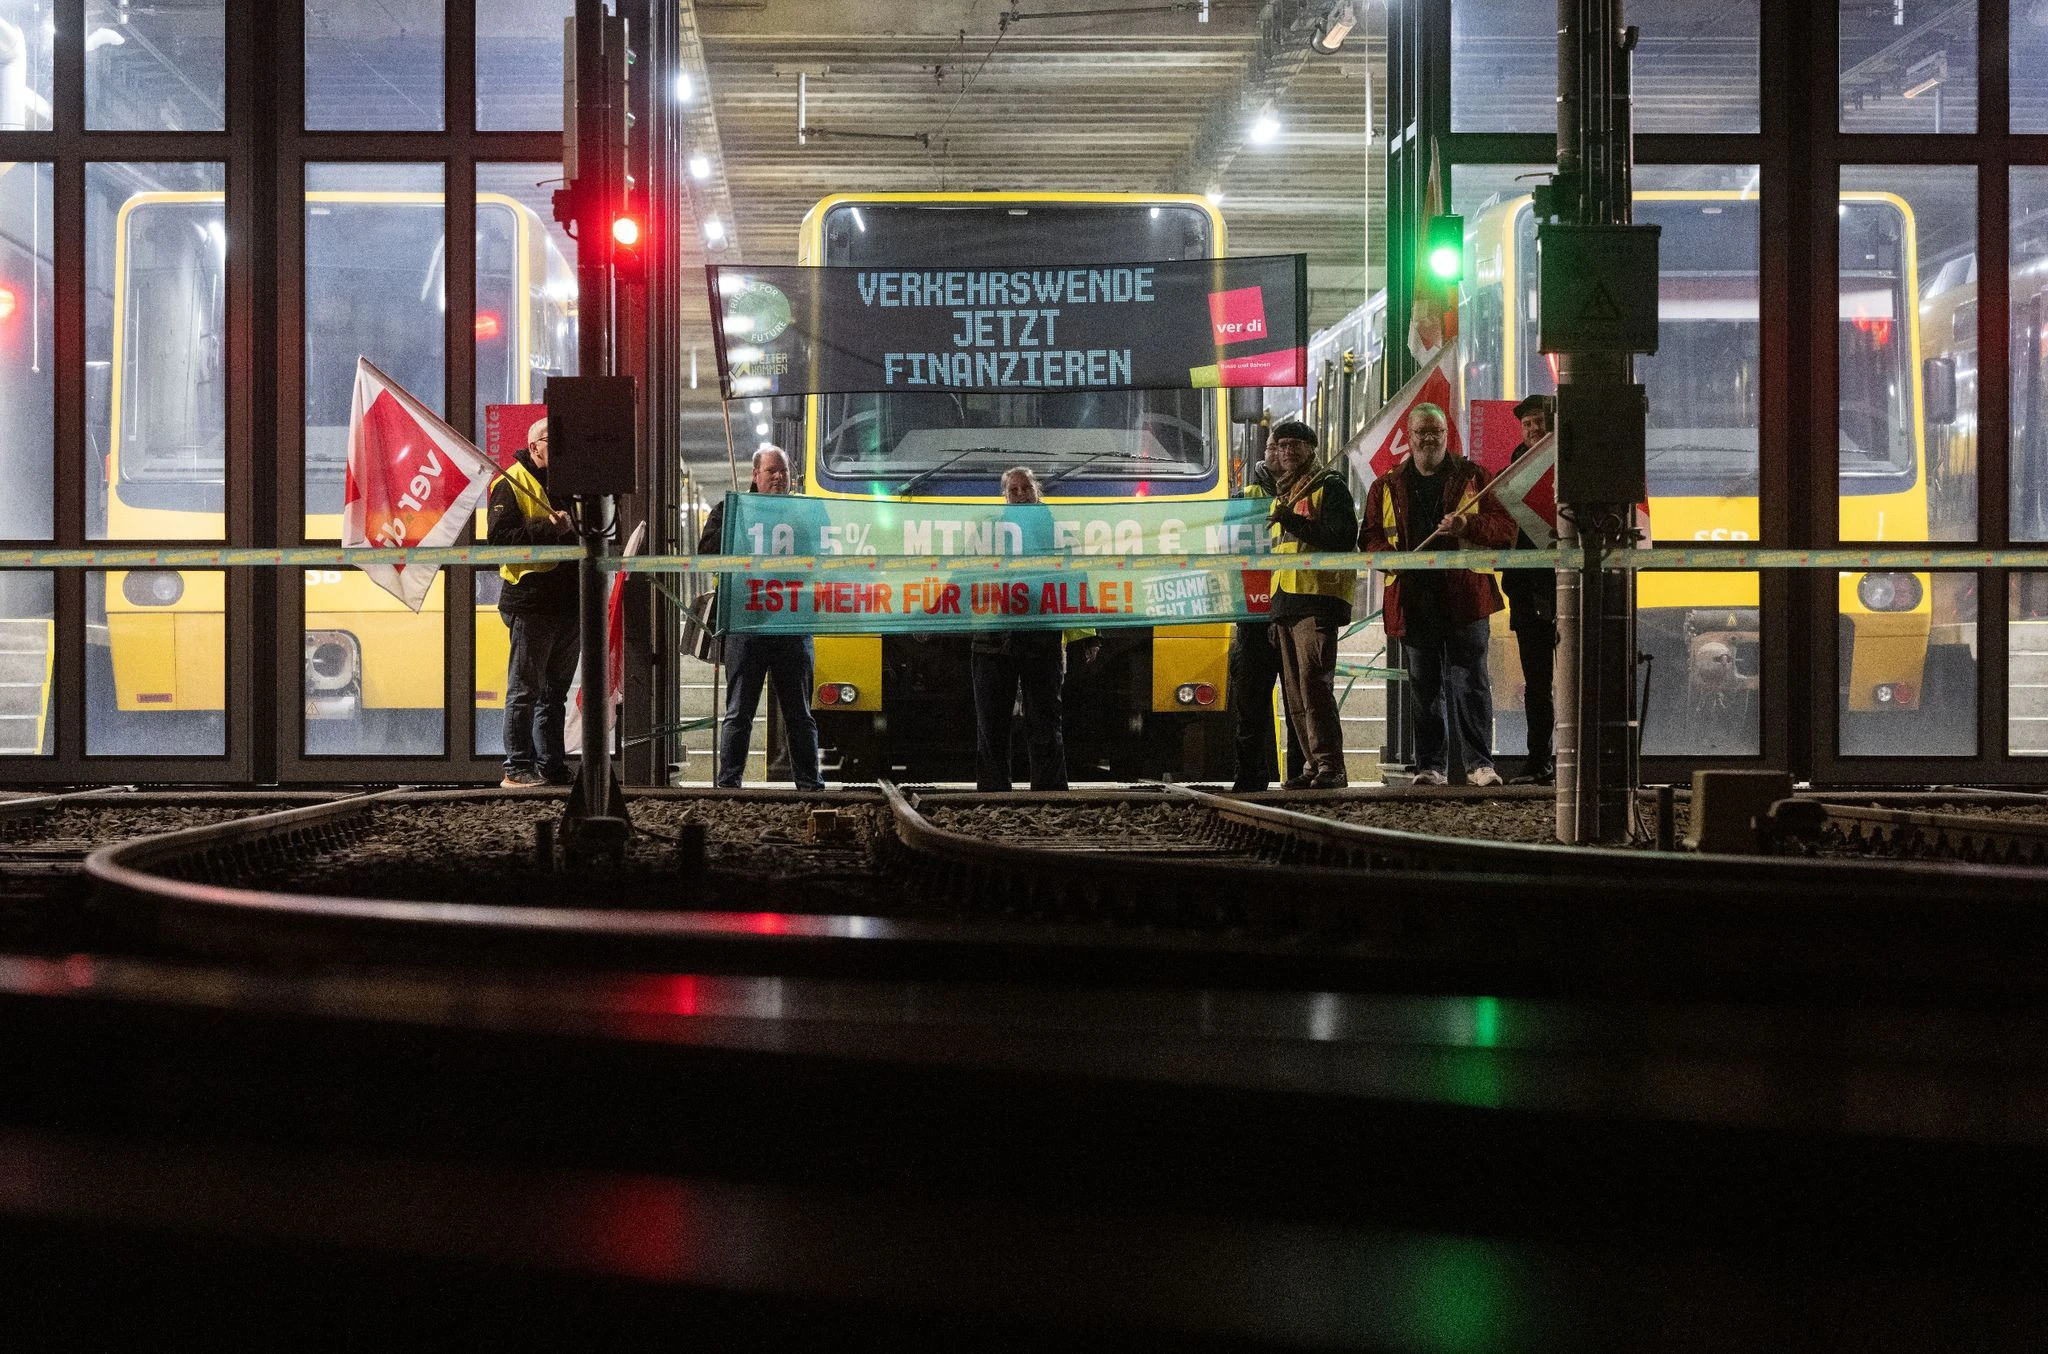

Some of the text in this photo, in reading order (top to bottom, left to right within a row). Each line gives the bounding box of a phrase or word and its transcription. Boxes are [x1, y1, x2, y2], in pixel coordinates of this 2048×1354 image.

[759, 284, 779, 297] FOR
[858, 267, 1155, 307] VERKEHRSWENDE
[751, 320, 787, 342] FUTURE
[953, 309, 1061, 347] JETZT
[884, 349, 1133, 387] FINANZIEREN
[1158, 518, 1188, 556] €
[744, 577, 1133, 615] IST MEHR FÜR UNS ALLE!
[1143, 572, 1231, 603] ZUSAMMEN
[1191, 594, 1234, 616] MEHR
